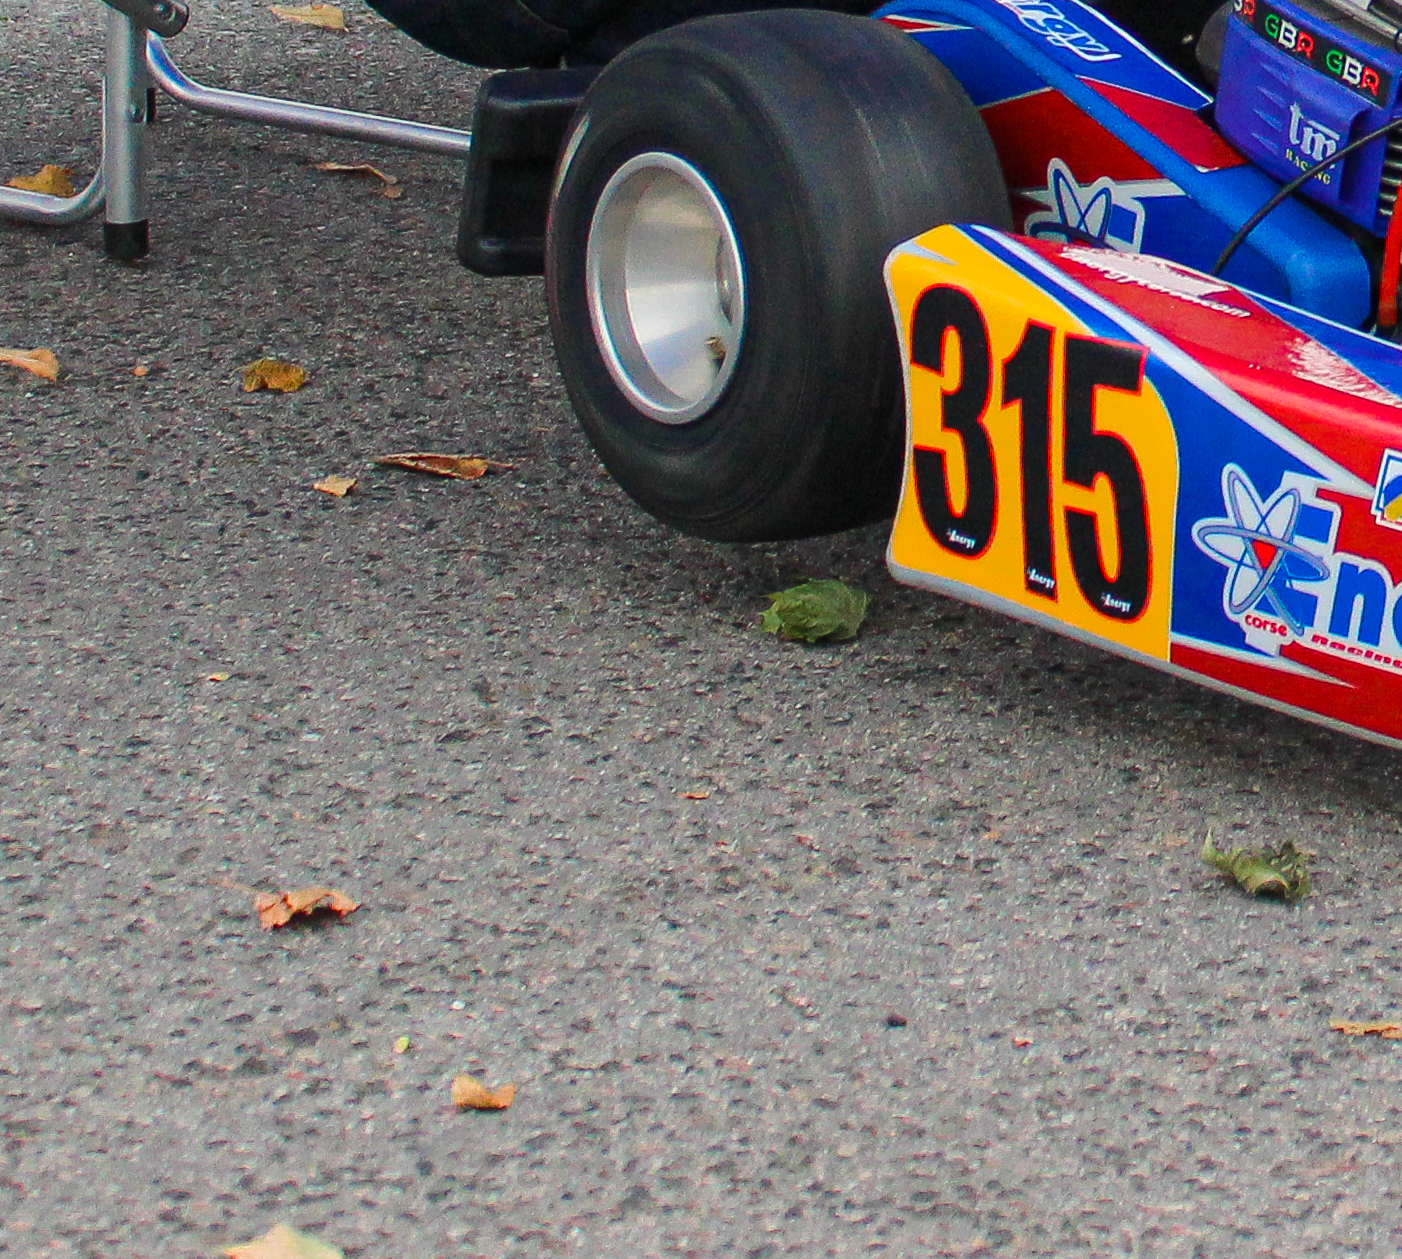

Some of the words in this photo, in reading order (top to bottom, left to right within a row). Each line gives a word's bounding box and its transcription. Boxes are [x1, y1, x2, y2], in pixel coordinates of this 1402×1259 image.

[1265, 13, 1316, 60] GBR
[1326, 49, 1381, 97] GBR
[1289, 101, 1341, 162] tm
[910, 283, 1153, 625] 315
[1244, 614, 1288, 637] corse
